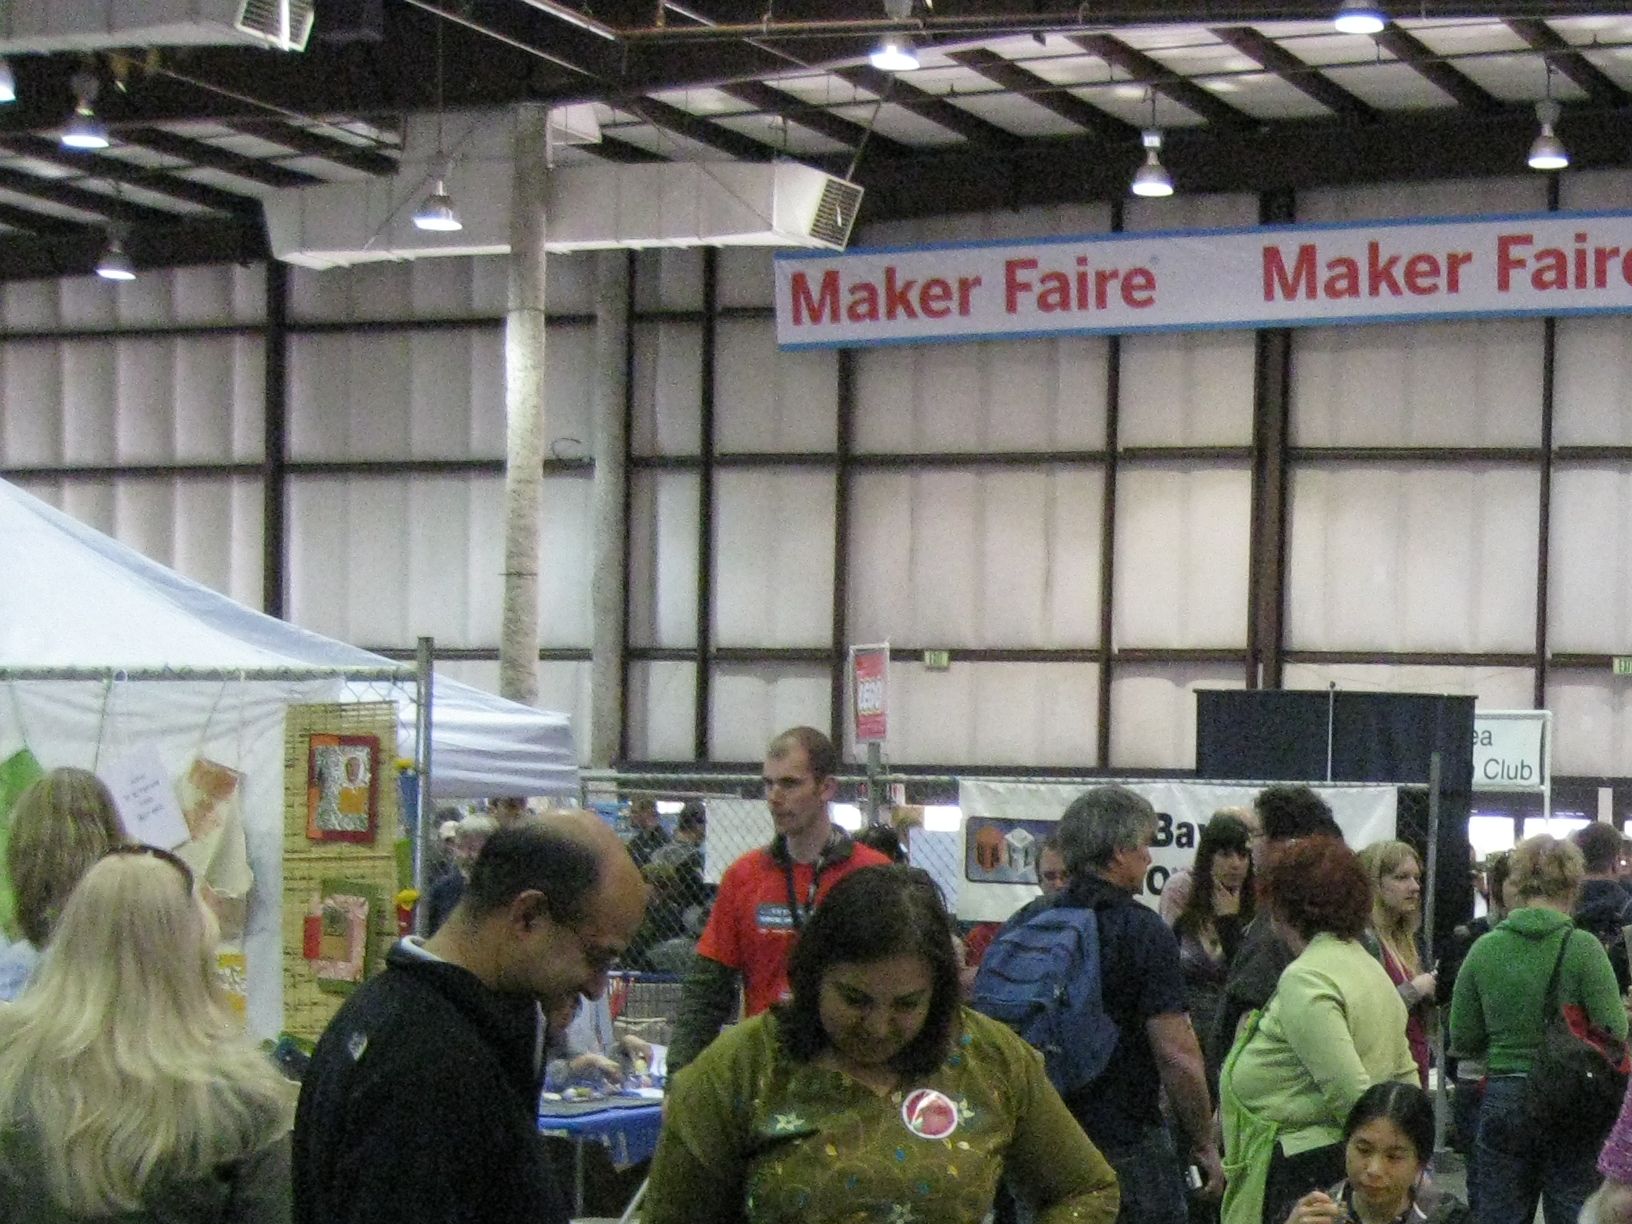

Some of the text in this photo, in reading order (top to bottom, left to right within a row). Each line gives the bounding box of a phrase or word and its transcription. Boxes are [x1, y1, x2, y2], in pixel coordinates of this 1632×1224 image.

[790, 256, 1157, 326] Maker Faire
[1262, 240, 1472, 302] Maker
[1483, 758, 1533, 780] Club
[1149, 812, 1206, 849] Ba
